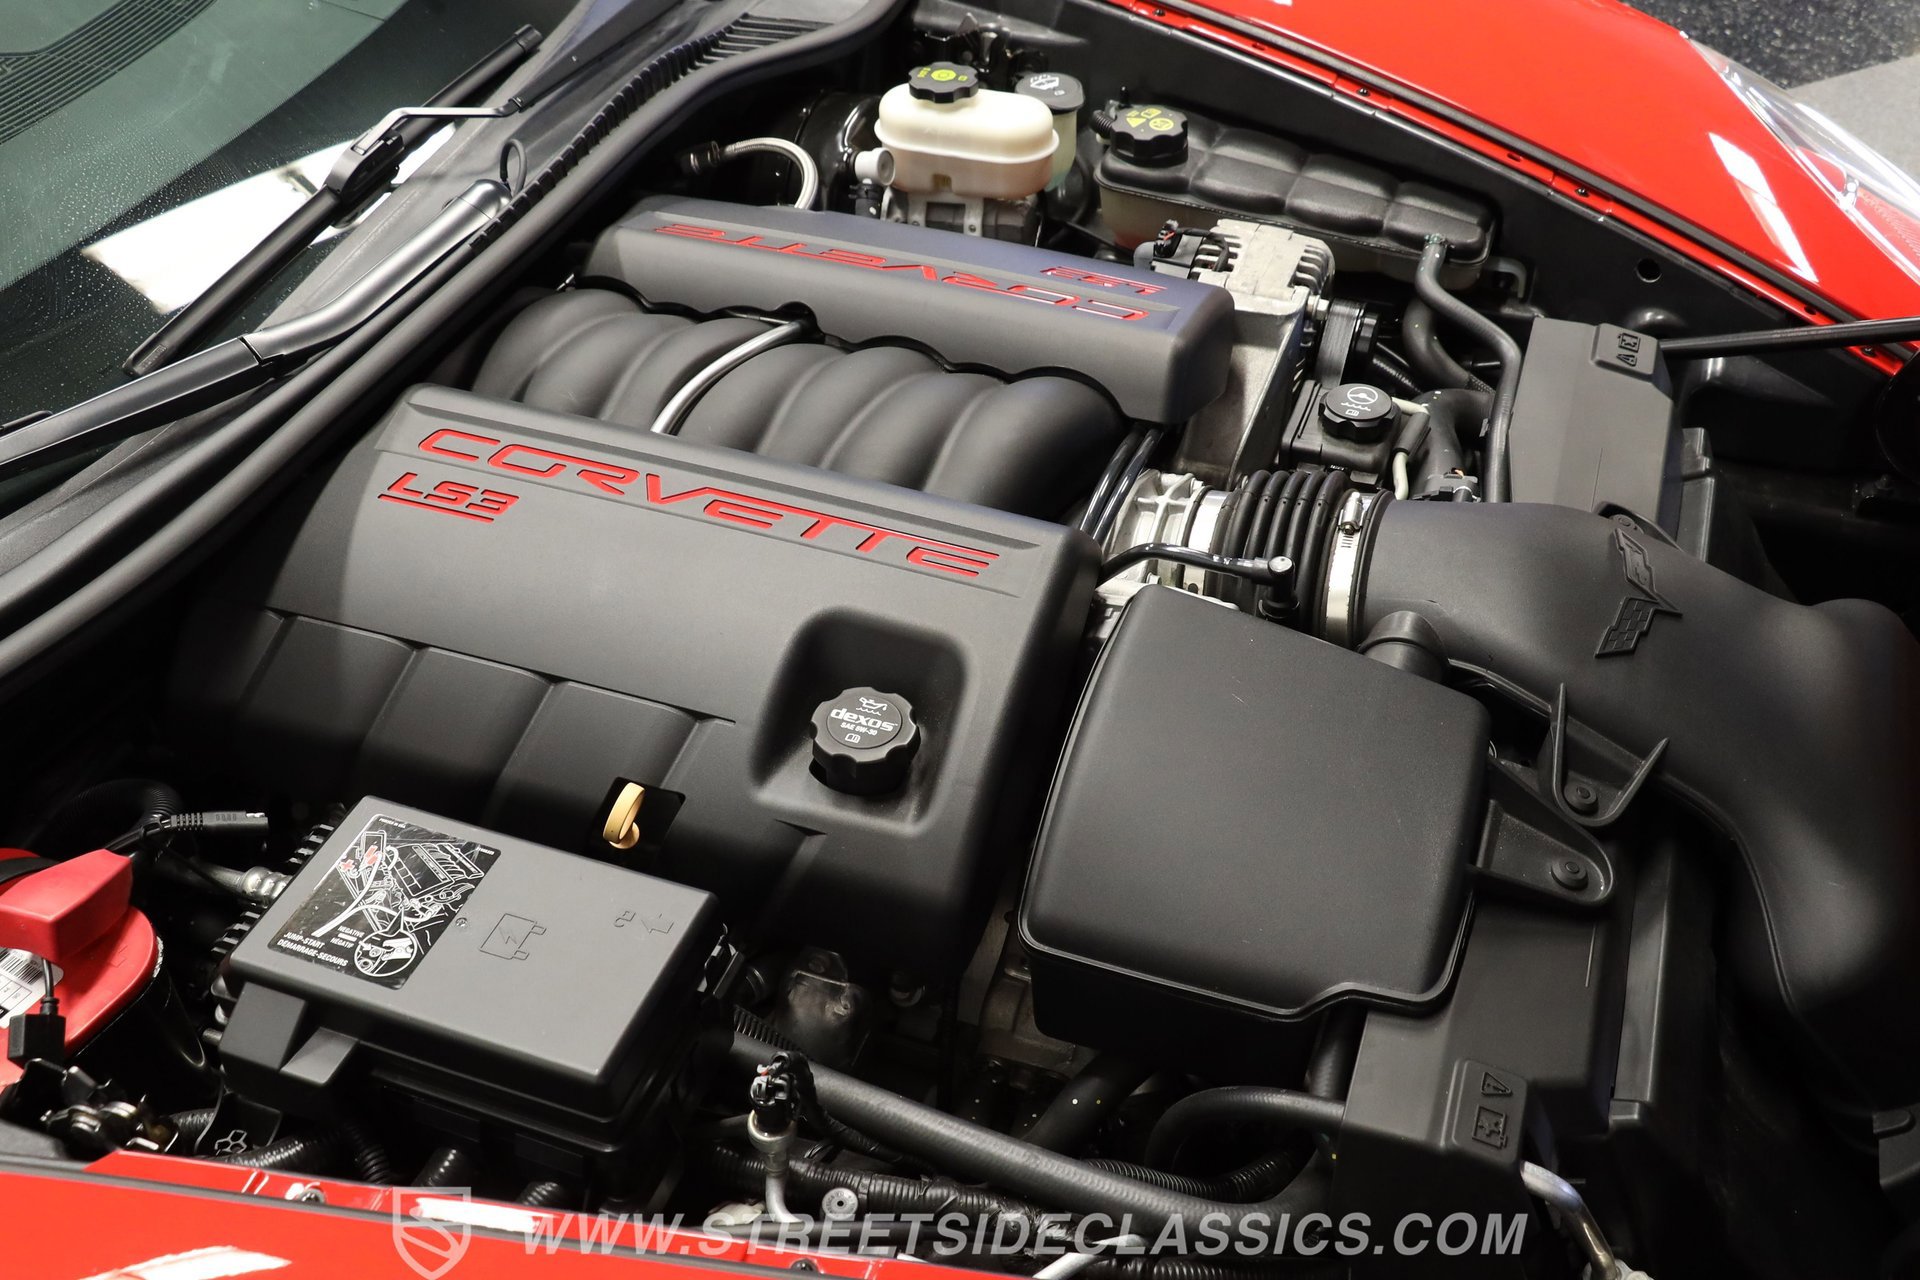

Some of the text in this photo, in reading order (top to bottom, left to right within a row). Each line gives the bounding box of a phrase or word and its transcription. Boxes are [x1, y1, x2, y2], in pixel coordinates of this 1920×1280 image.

[653, 223, 1150, 321] CORVETTE
[1040, 265, 1163, 295] LS3
[384, 471, 521, 517] LS3
[417, 428, 1001, 578] CORVETTE
[840, 721, 856, 731] SAE
[283, 931, 325, 949] JUMP-START
